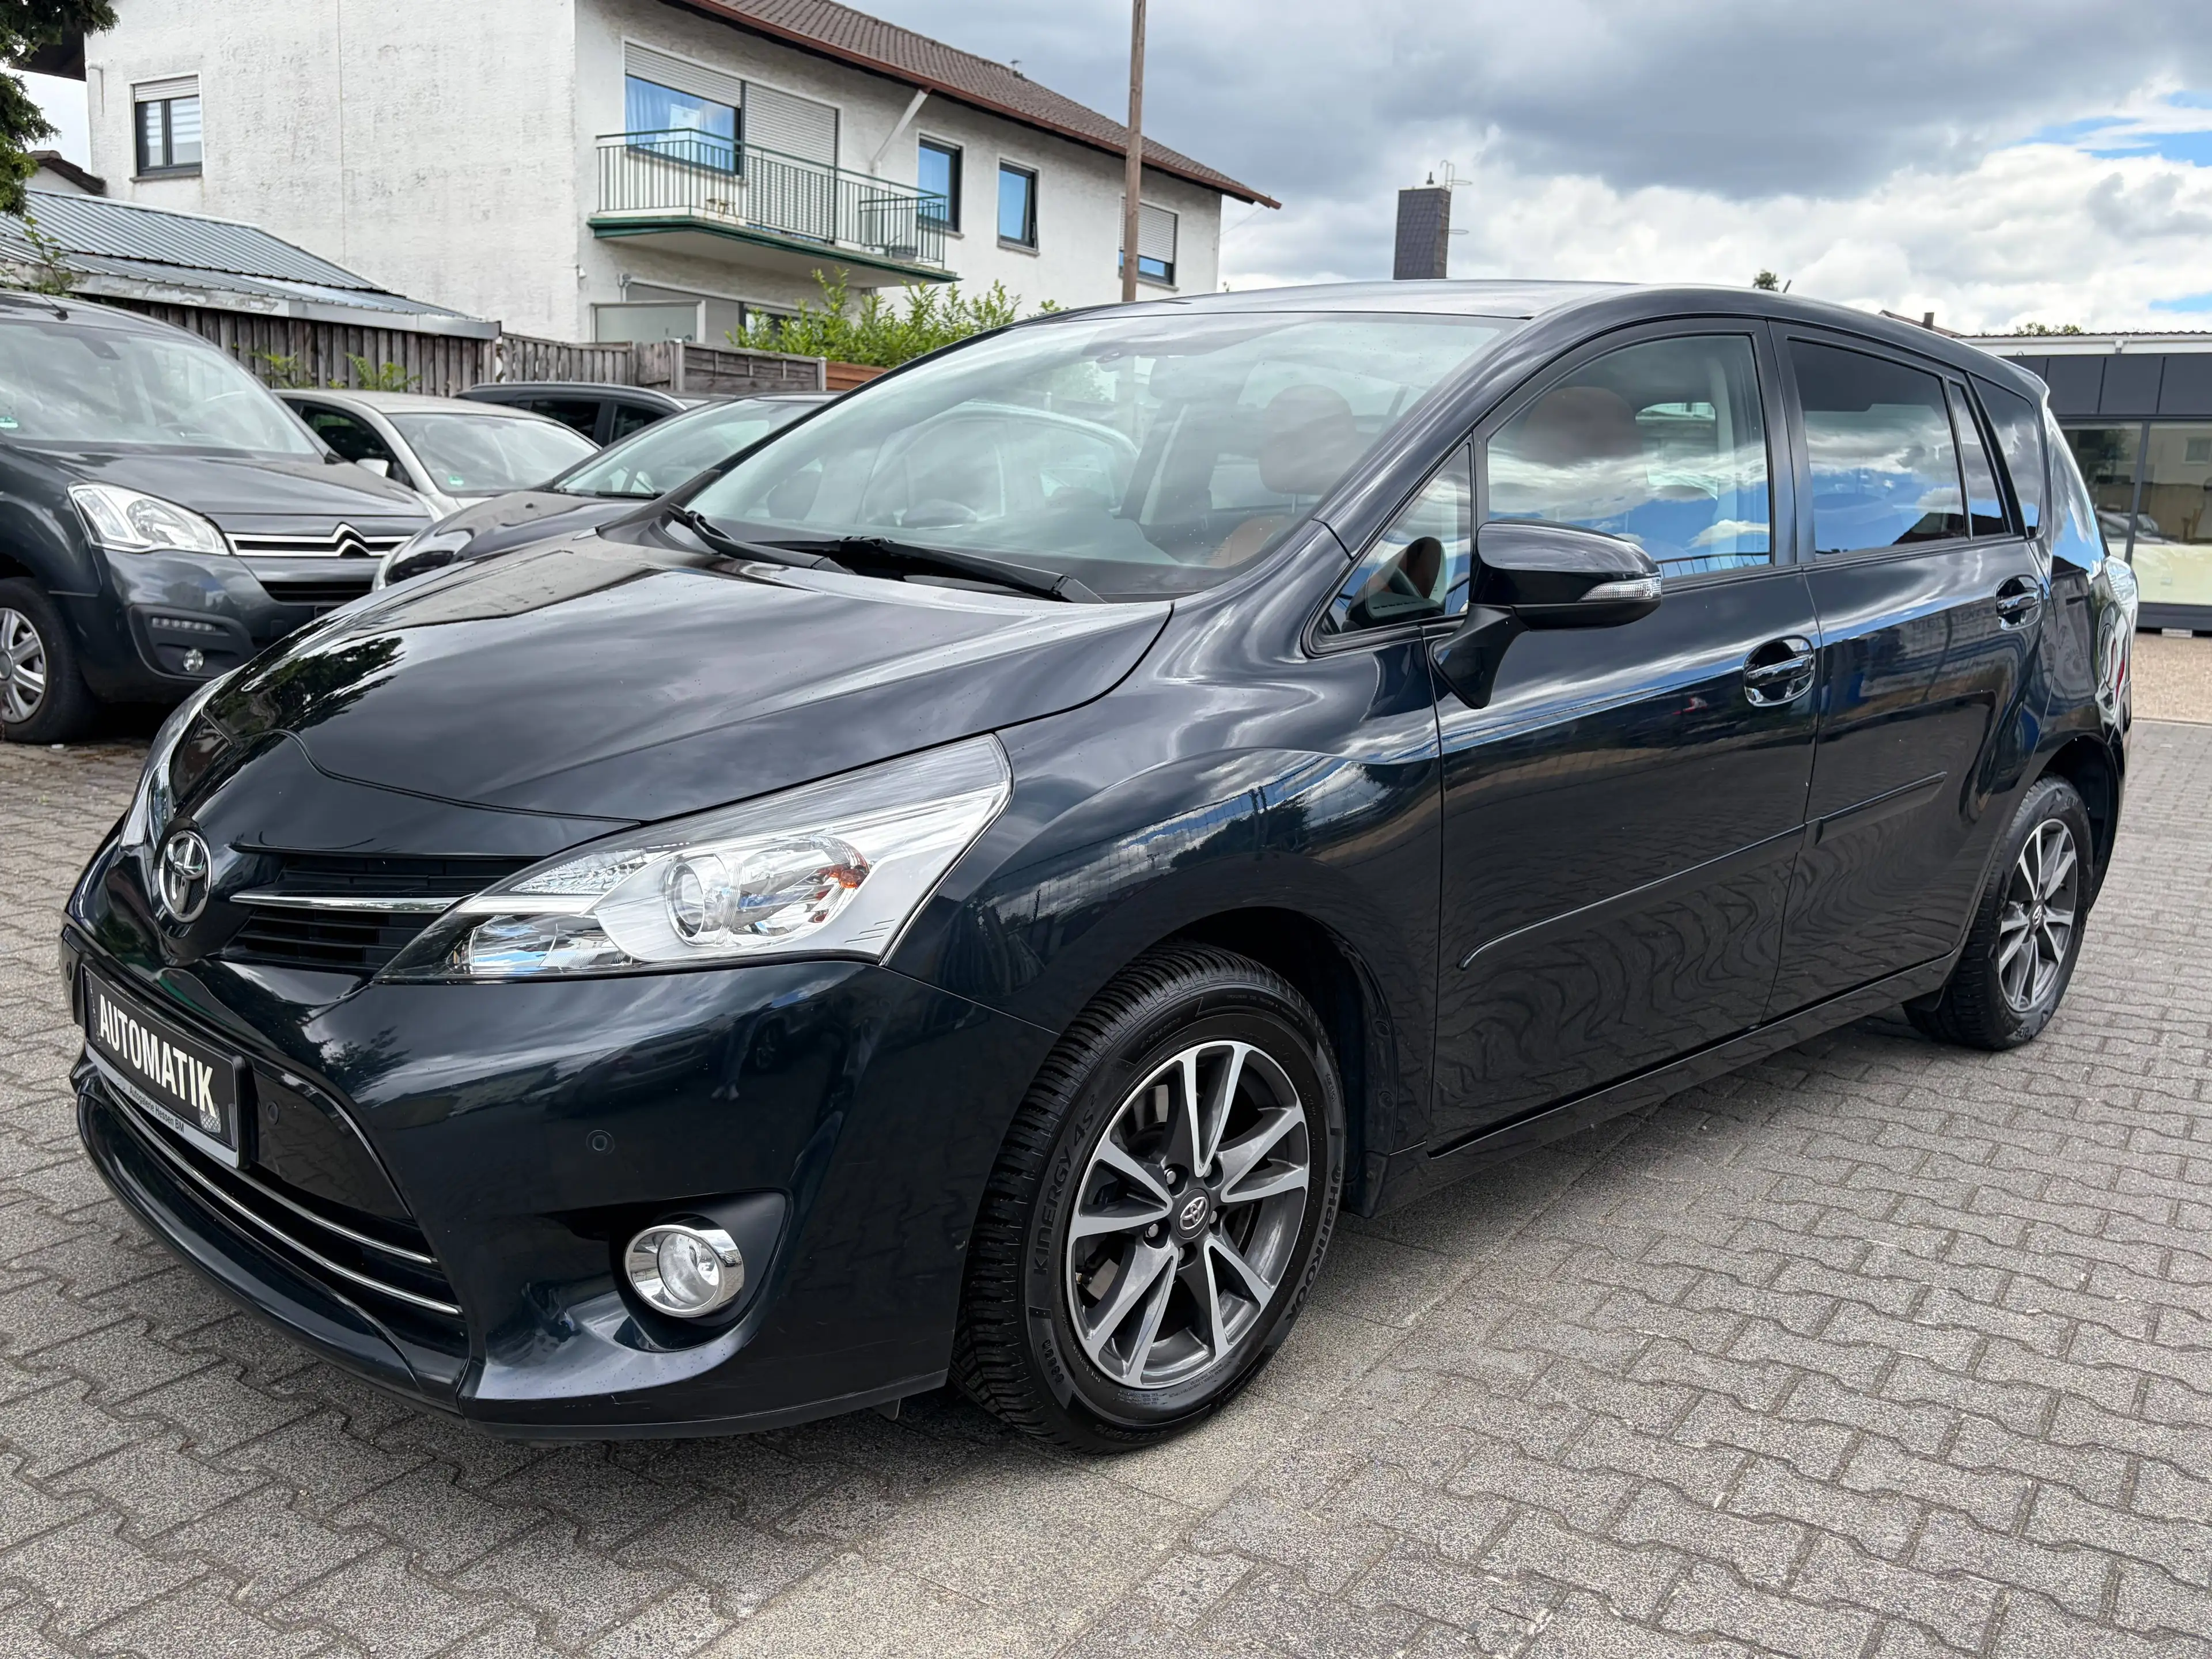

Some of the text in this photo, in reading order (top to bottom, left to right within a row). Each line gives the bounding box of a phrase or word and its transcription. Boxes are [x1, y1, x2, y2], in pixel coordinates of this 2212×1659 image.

[100, 994, 217, 1118] AUTOMATIK
[129, 1086, 184, 1133] Autogalerie Hessen BM
[1033, 1145, 1071, 1275] KINERGY
